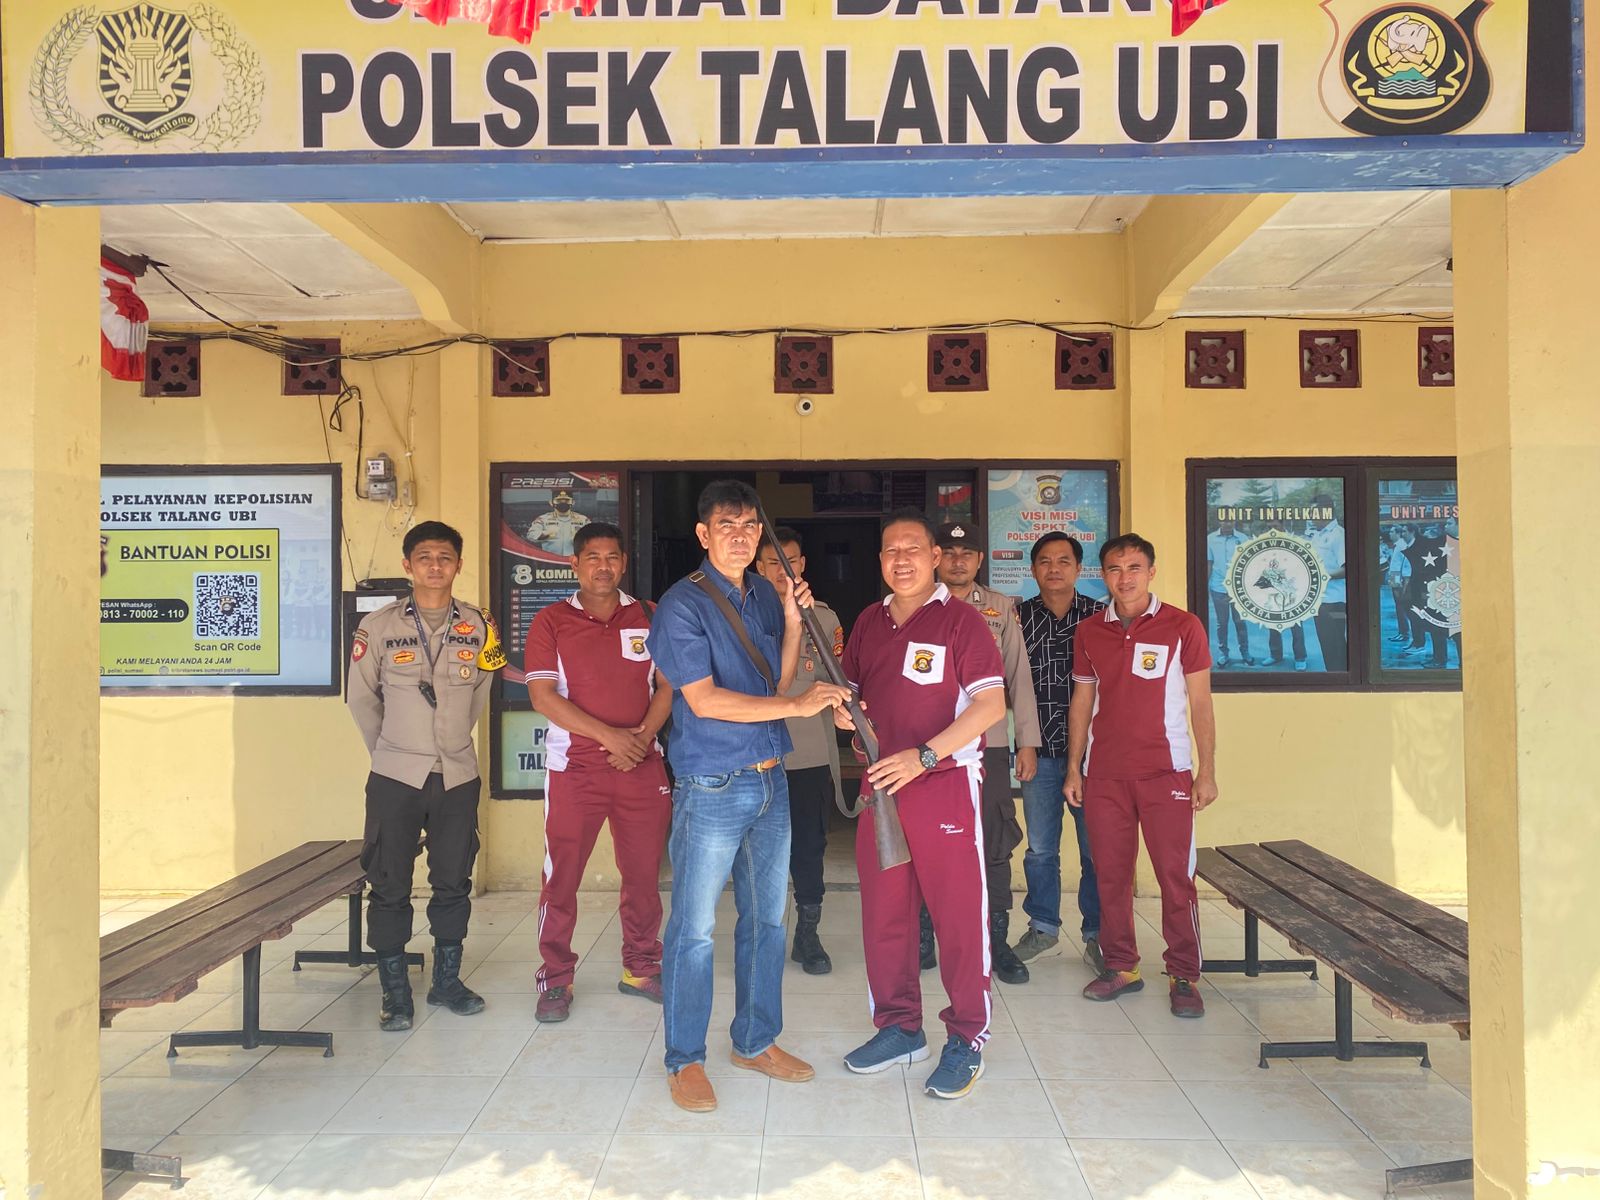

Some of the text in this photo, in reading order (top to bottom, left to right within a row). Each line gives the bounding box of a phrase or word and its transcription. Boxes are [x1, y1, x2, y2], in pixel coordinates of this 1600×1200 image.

[302, 44, 1278, 148] POLSEK TALANG UBI
[112, 494, 207, 505] PELAYANAN
[214, 493, 312, 504] KEPOLISIAN
[158, 511, 221, 521] TALANG
[229, 510, 257, 521] UBI
[1021, 511, 1077, 520] VISI MISI
[1217, 507, 1333, 520] UNIT INTELKAM
[1391, 506, 1425, 519] UNIT
[1033, 523, 1067, 531] SPKT
[1080, 532, 1095, 541] UBI
[120, 544, 271, 560] BANTUAN POLISI
[512, 564, 533, 585] 8
[129, 609, 159, 618] 70002
[167, 609, 184, 618] 110
[194, 643, 261, 651] Scan QR Code
[386, 637, 418, 649] RYAN
